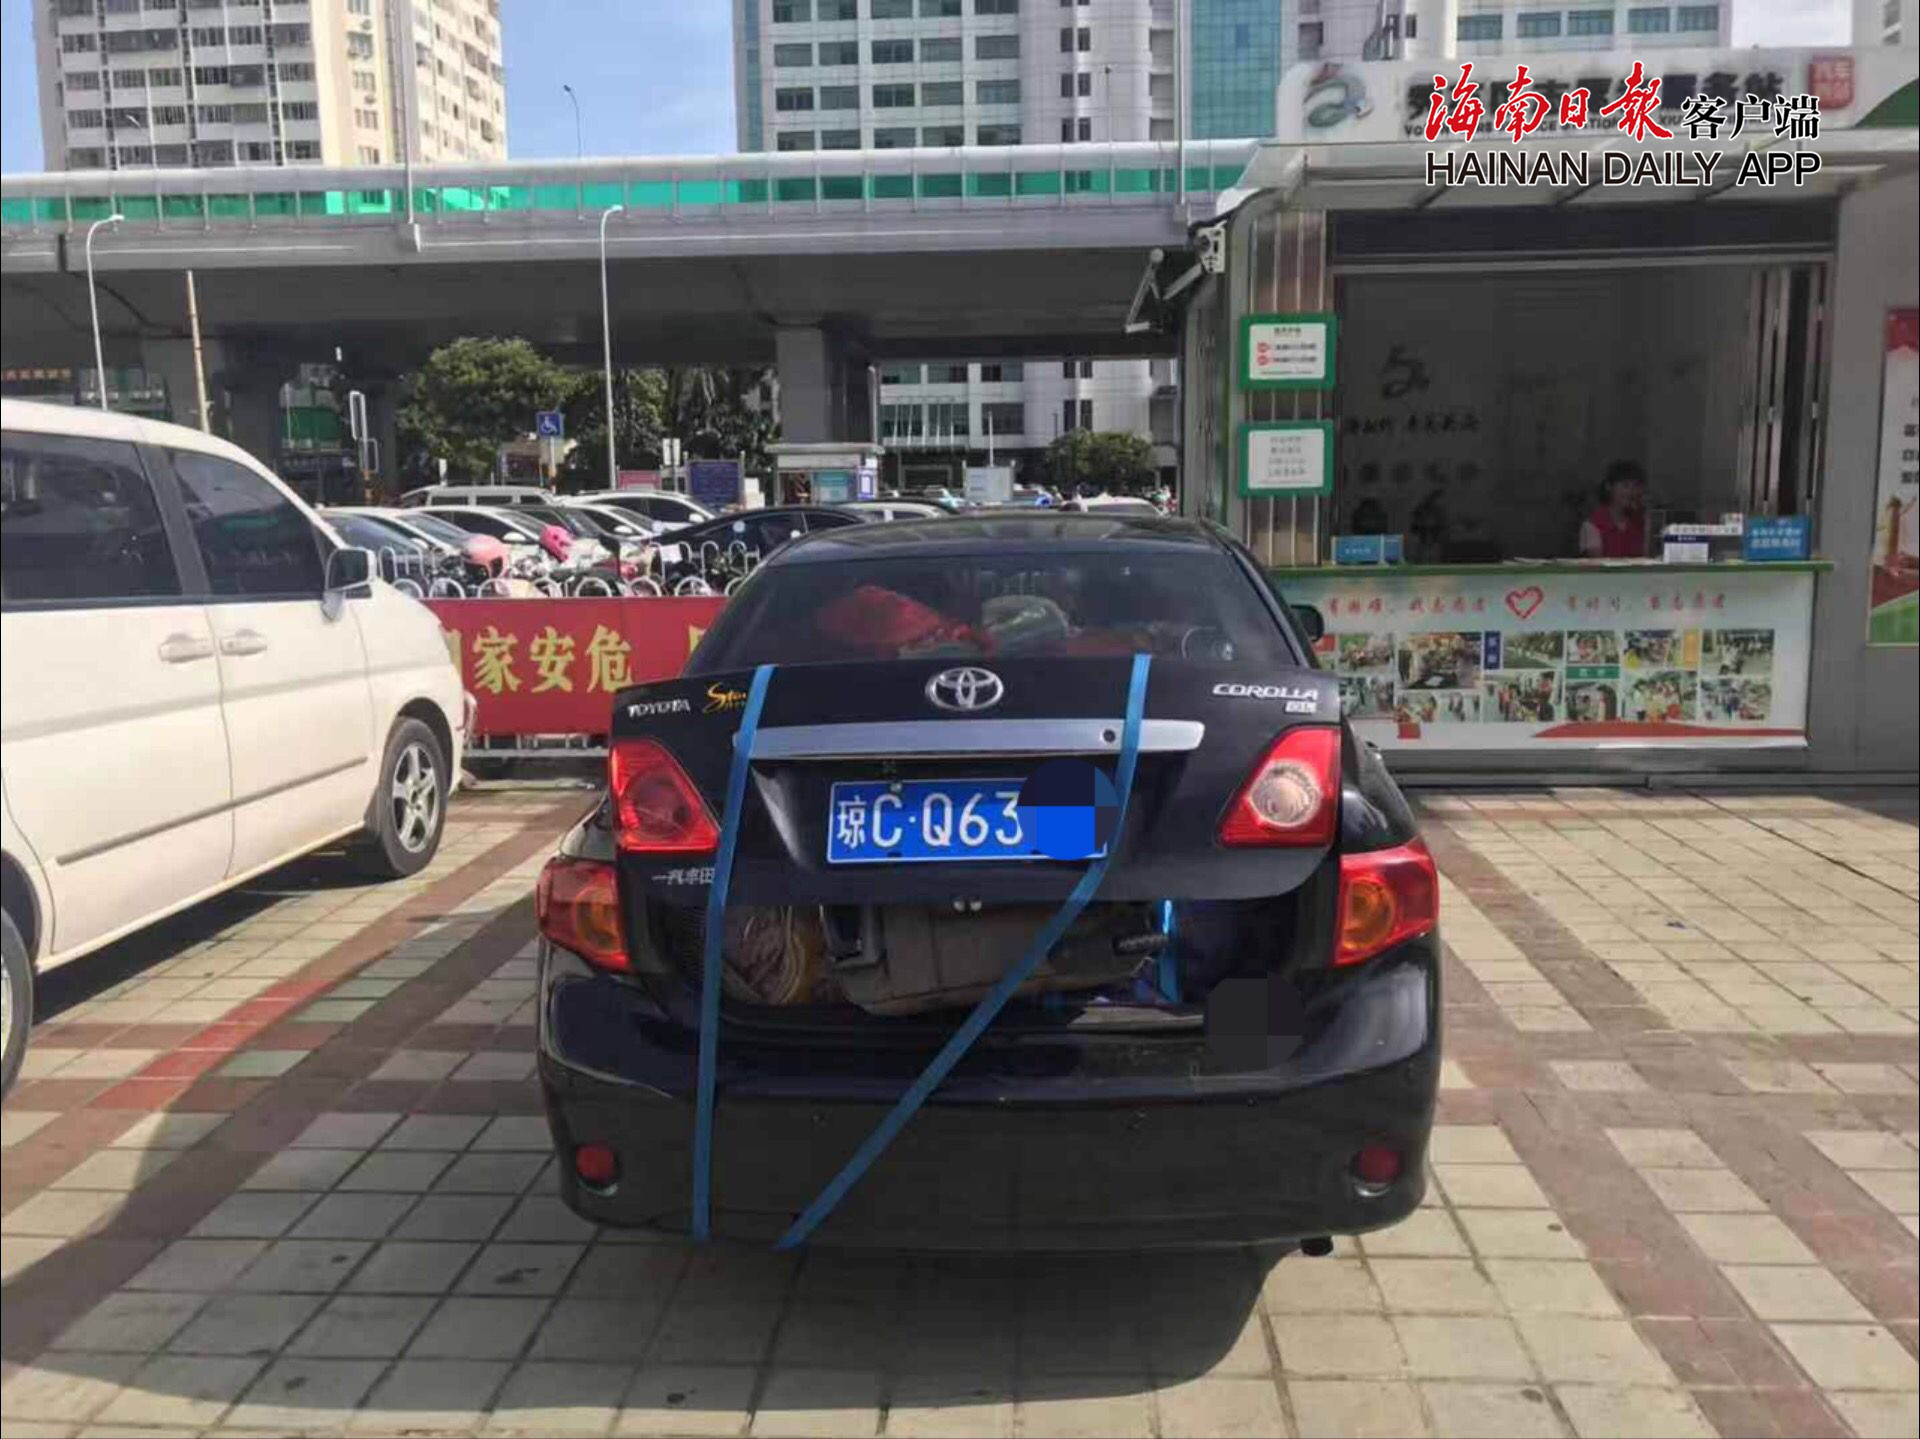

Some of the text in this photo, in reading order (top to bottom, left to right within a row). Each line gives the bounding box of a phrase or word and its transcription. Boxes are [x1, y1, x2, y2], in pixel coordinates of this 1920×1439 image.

[1212, 683, 1319, 701] COROLLA
[628, 699, 691, 718] TOYOTA
[836, 790, 1024, 850] 琼C·Q63
